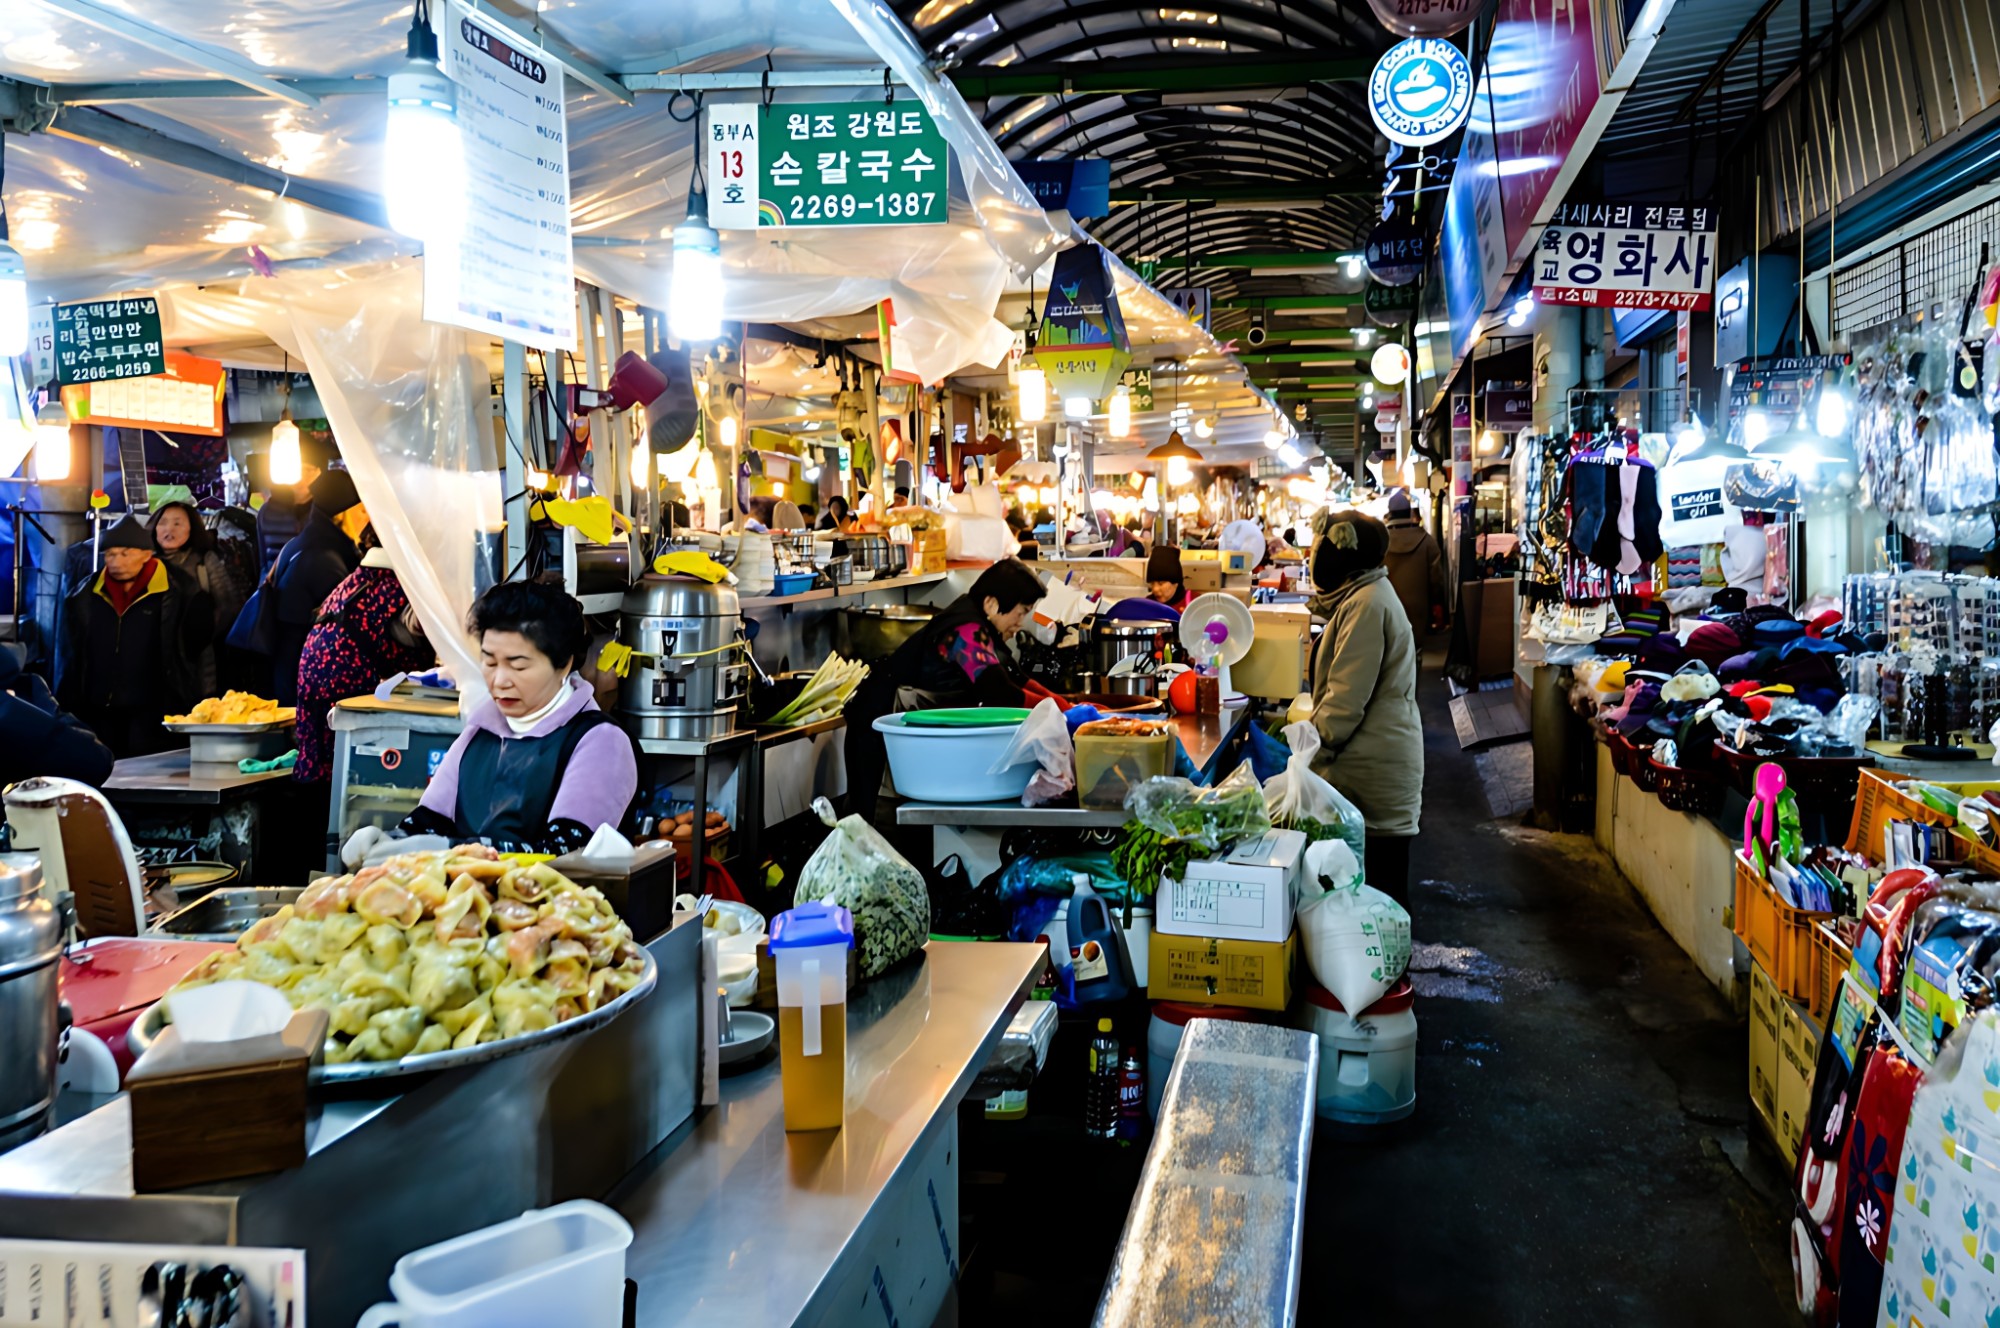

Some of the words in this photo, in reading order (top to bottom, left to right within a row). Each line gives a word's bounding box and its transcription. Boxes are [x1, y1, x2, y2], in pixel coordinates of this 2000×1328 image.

[712, 123, 754, 141] 동부A
[786, 113, 837, 140] 원조
[847, 110, 923, 138] 강원도
[720, 150, 744, 178] 13
[722, 183, 745, 203] 호
[789, 192, 936, 219] 2269-1387
[1567, 232, 1710, 289] 영화사
[1615, 291, 1700, 308] 2273-7477
[34, 335, 52, 352] 15
